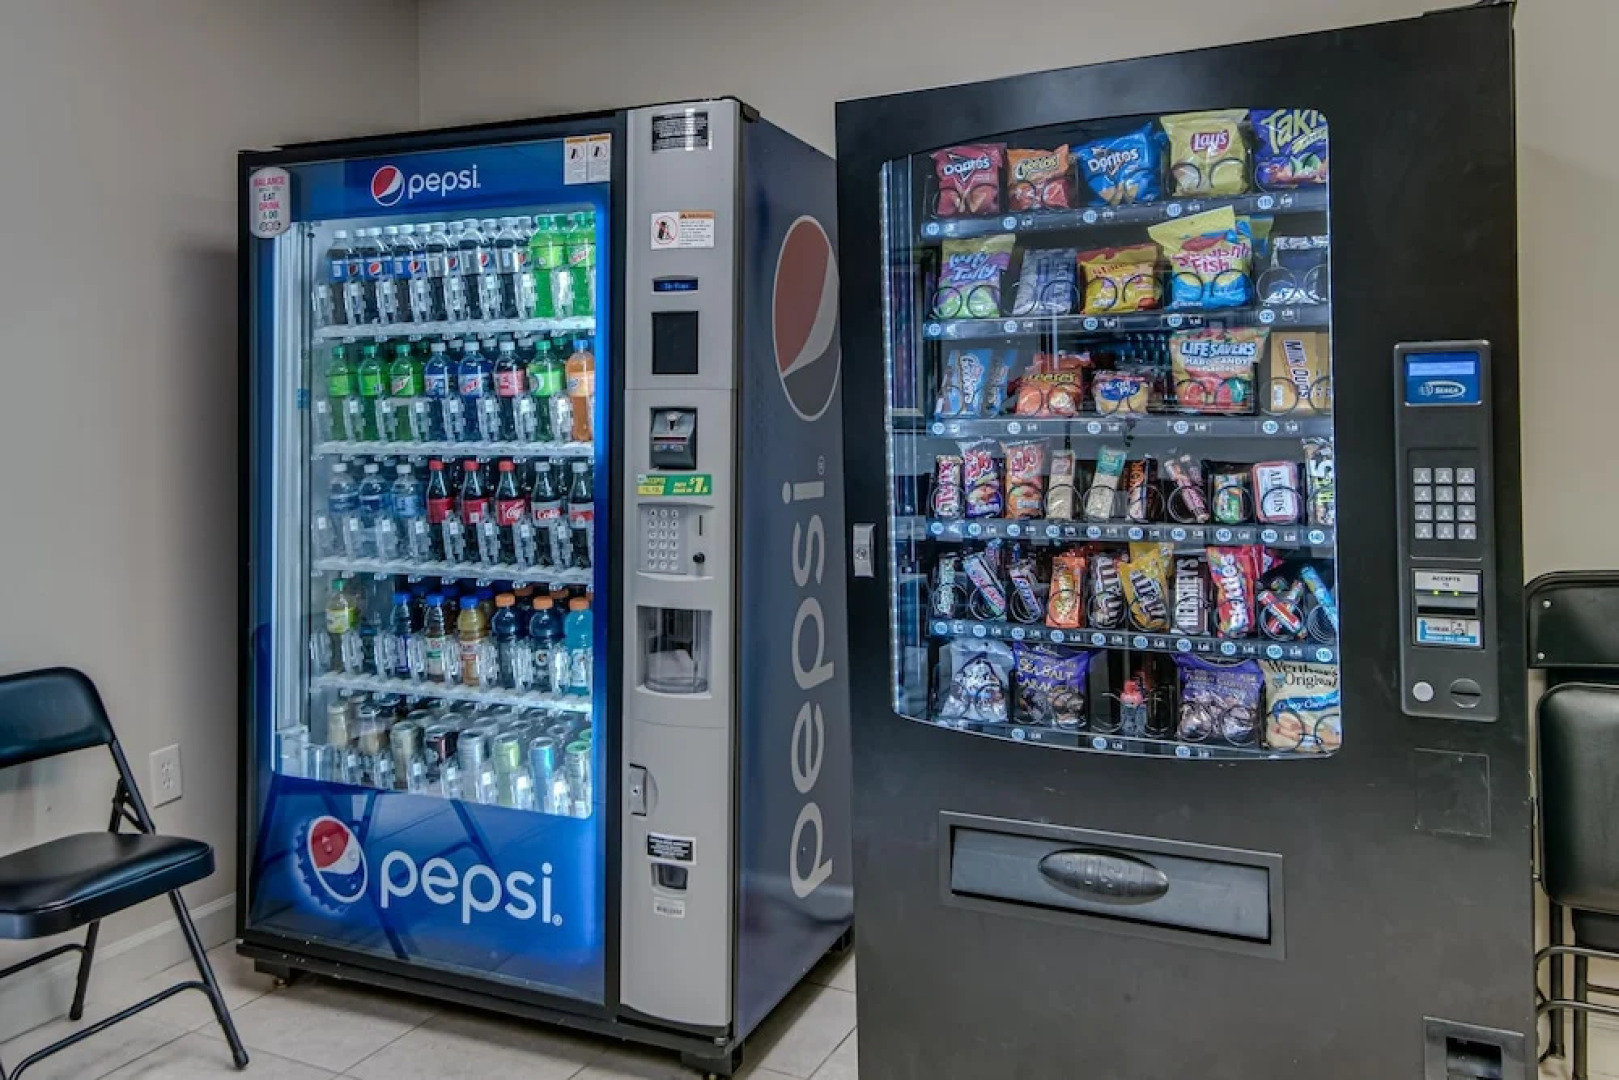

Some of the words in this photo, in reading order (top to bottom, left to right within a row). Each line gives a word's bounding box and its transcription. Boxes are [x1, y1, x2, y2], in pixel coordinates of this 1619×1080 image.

[1194, 133, 1228, 156] Lay's
[943, 157, 990, 175] Doritos
[1088, 149, 1138, 172] Doritos
[408, 163, 479, 199] pepsi
[1191, 259, 1230, 274] Fish
[1181, 342, 1209, 356] LIFE
[1210, 342, 1257, 357] SAVERS
[1176, 559, 1200, 626] HERSHEY'S
[781, 480, 835, 898] pepsi
[1286, 672, 1338, 688] Original
[379, 850, 553, 924] pepsi
